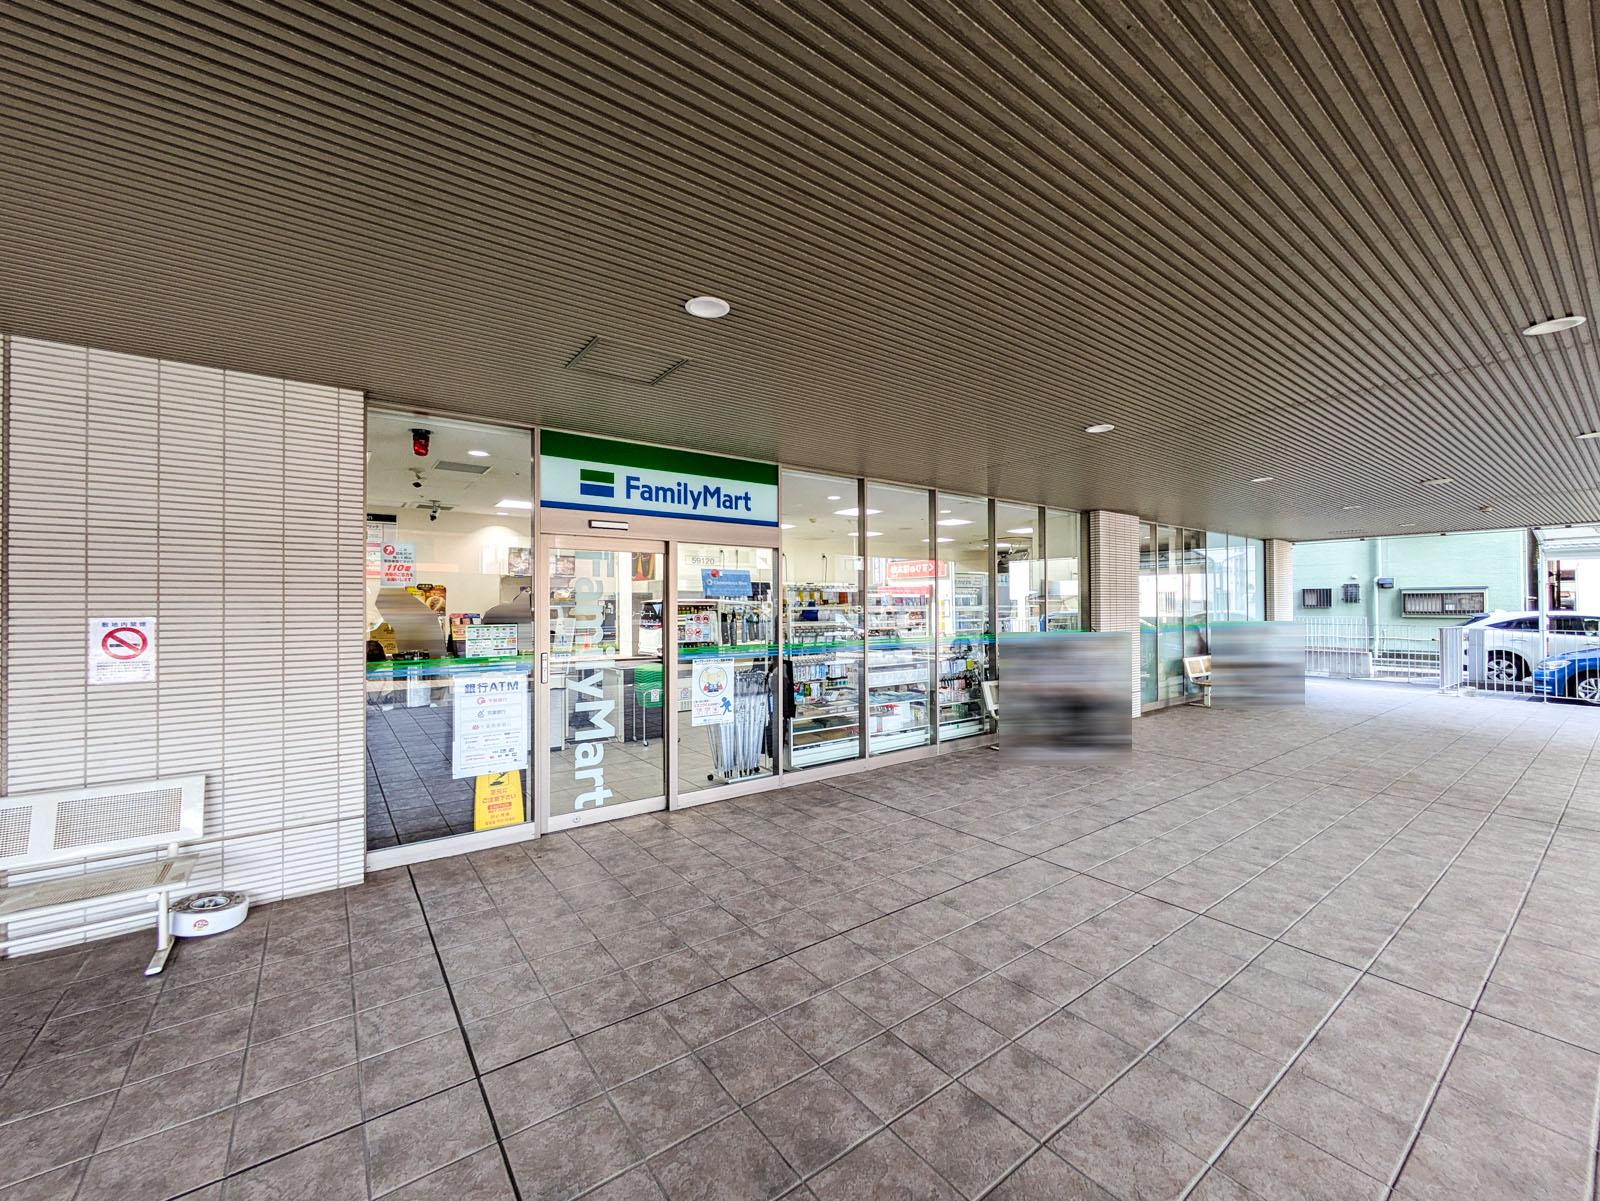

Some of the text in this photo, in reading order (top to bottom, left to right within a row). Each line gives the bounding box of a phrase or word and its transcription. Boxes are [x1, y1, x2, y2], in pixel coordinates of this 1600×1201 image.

[625, 475, 752, 512] FamilyMart
[691, 557, 715, 565] 59120
[464, 681, 519, 694] 銀行ATM
[567, 550, 616, 810] FamilyMart
